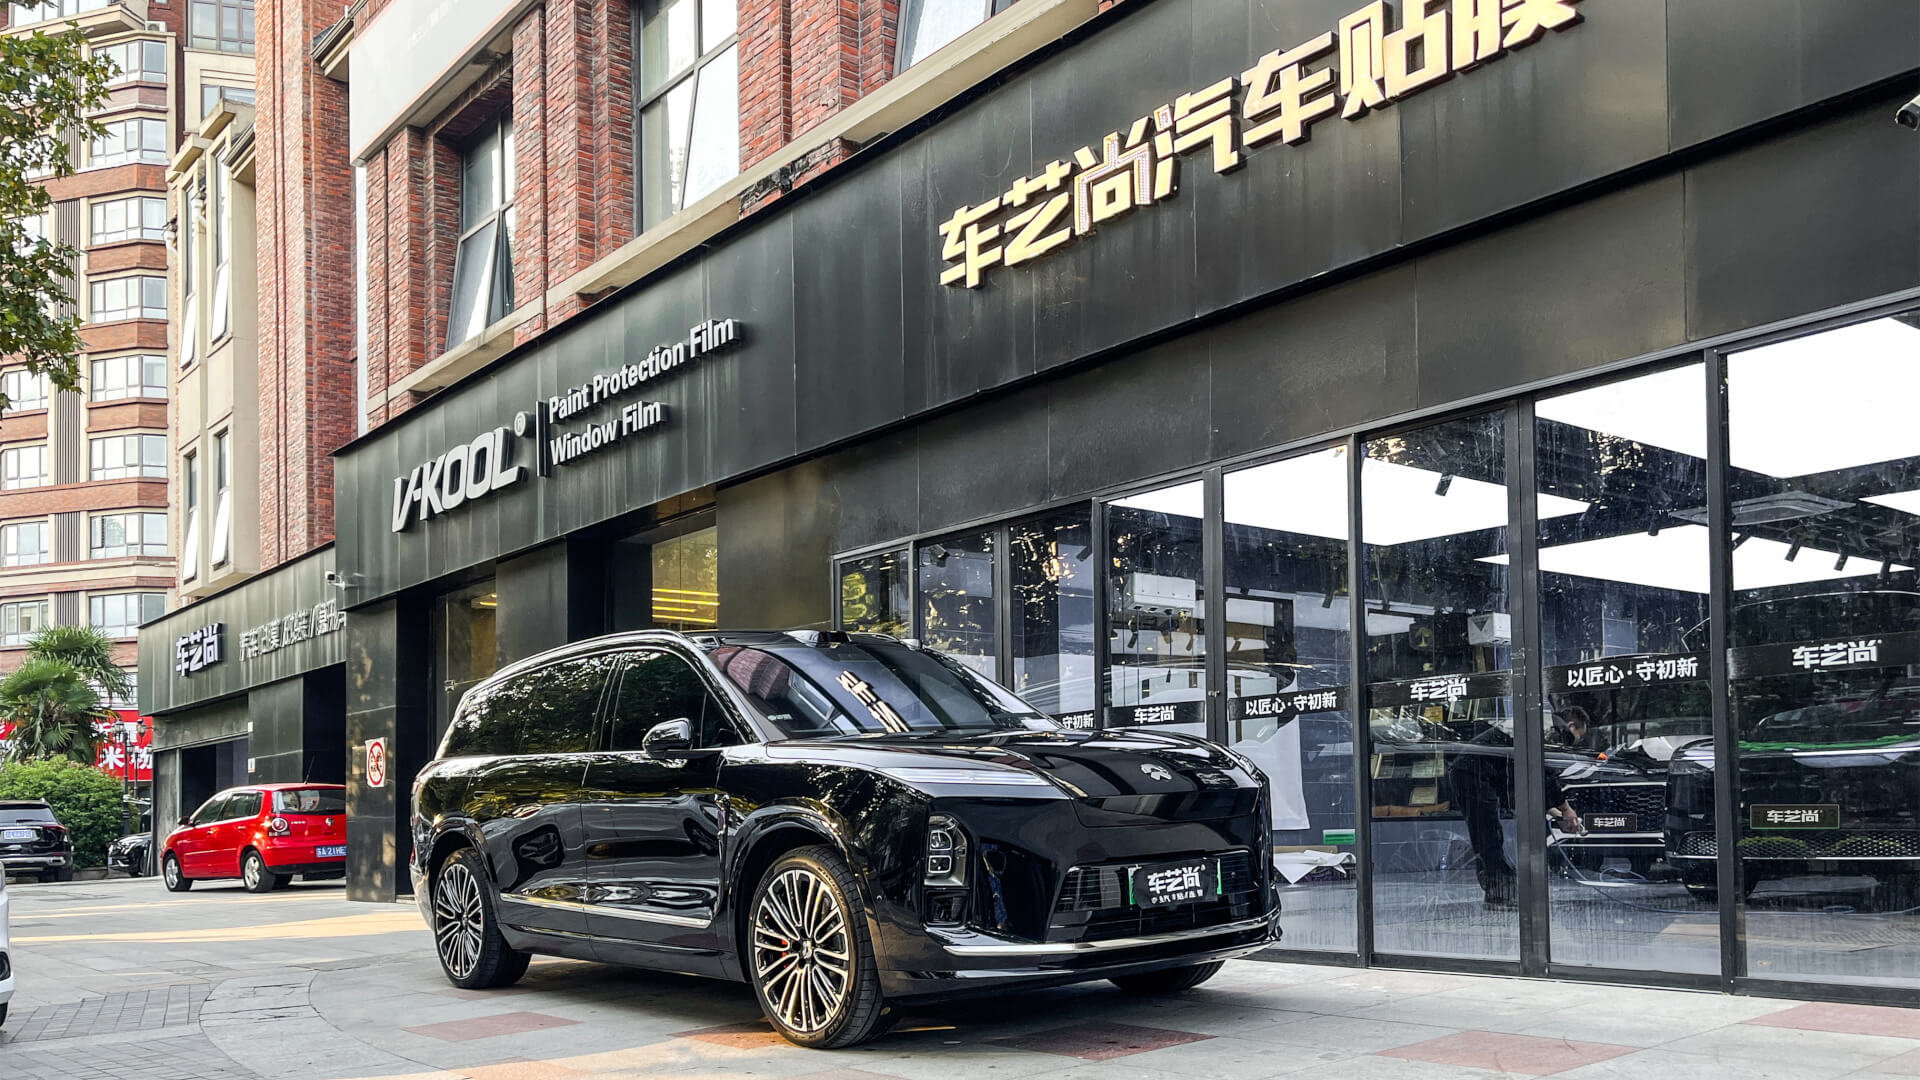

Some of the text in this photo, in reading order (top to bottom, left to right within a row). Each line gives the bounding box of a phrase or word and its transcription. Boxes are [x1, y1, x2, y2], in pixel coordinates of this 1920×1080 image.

[549, 318, 735, 424] Paint Protection Film
[550, 401, 662, 466] Window Film
[176, 622, 219, 677] 车艺尚
[1792, 640, 1878, 669] 车艺尚
[1410, 677, 1468, 702] 车艺尚
[1133, 704, 1176, 724] 车艺尚
[1593, 817, 1626, 828] 车艺尚
[1766, 809, 1820, 824] 车艺尚
[1147, 866, 1201, 894] 车艺尚
